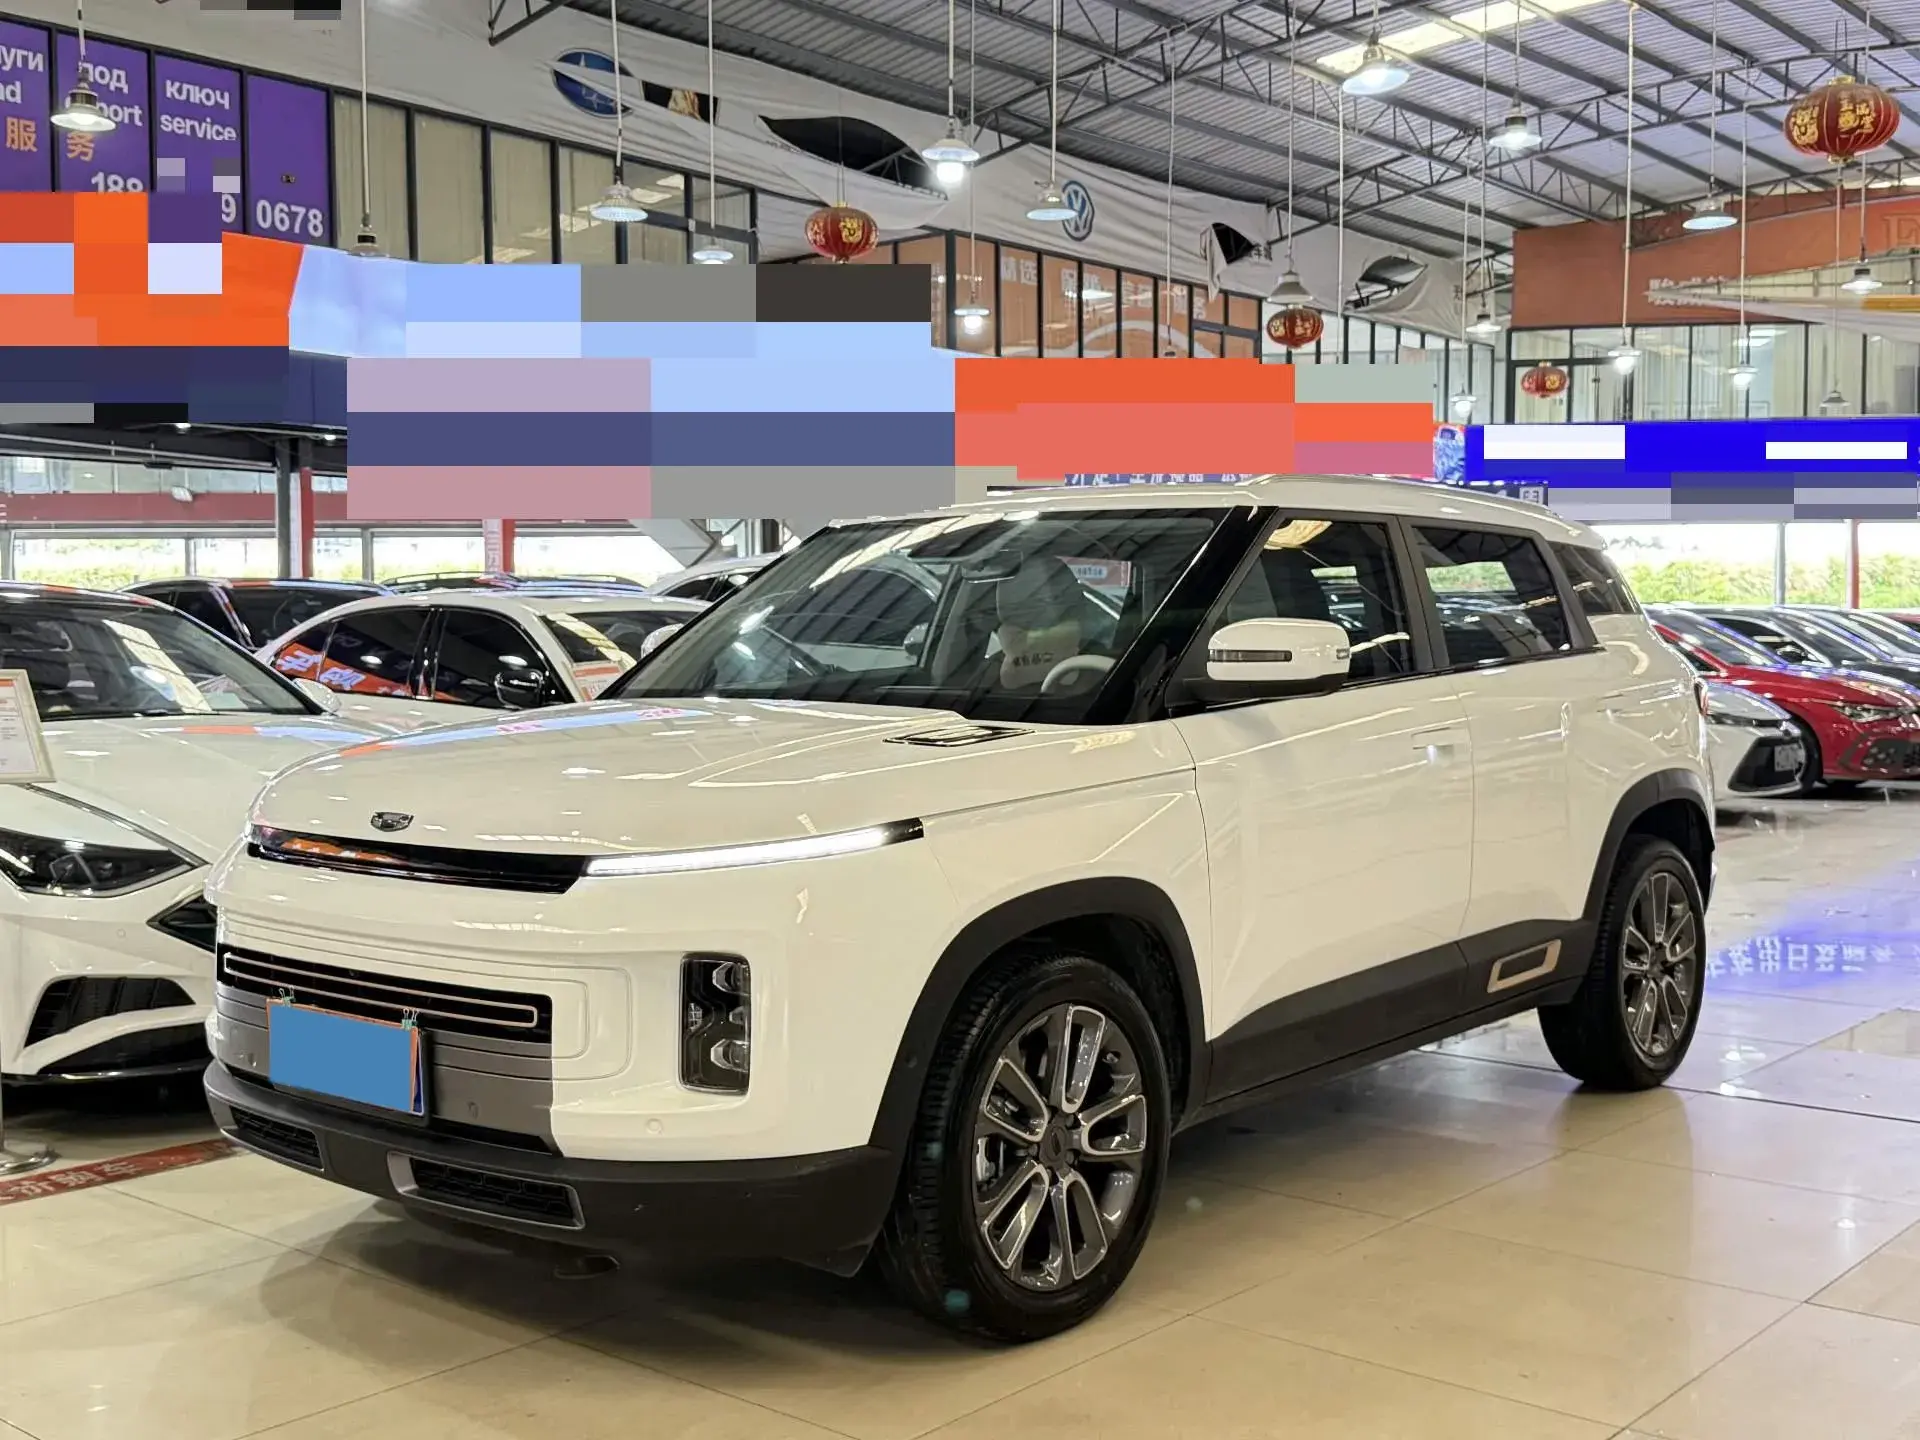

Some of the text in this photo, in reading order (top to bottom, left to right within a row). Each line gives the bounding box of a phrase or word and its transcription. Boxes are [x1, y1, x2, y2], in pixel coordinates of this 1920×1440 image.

[0, 45, 230, 110] уги под ключ
[160, 113, 237, 141] service
[256, 199, 324, 238] 0678
